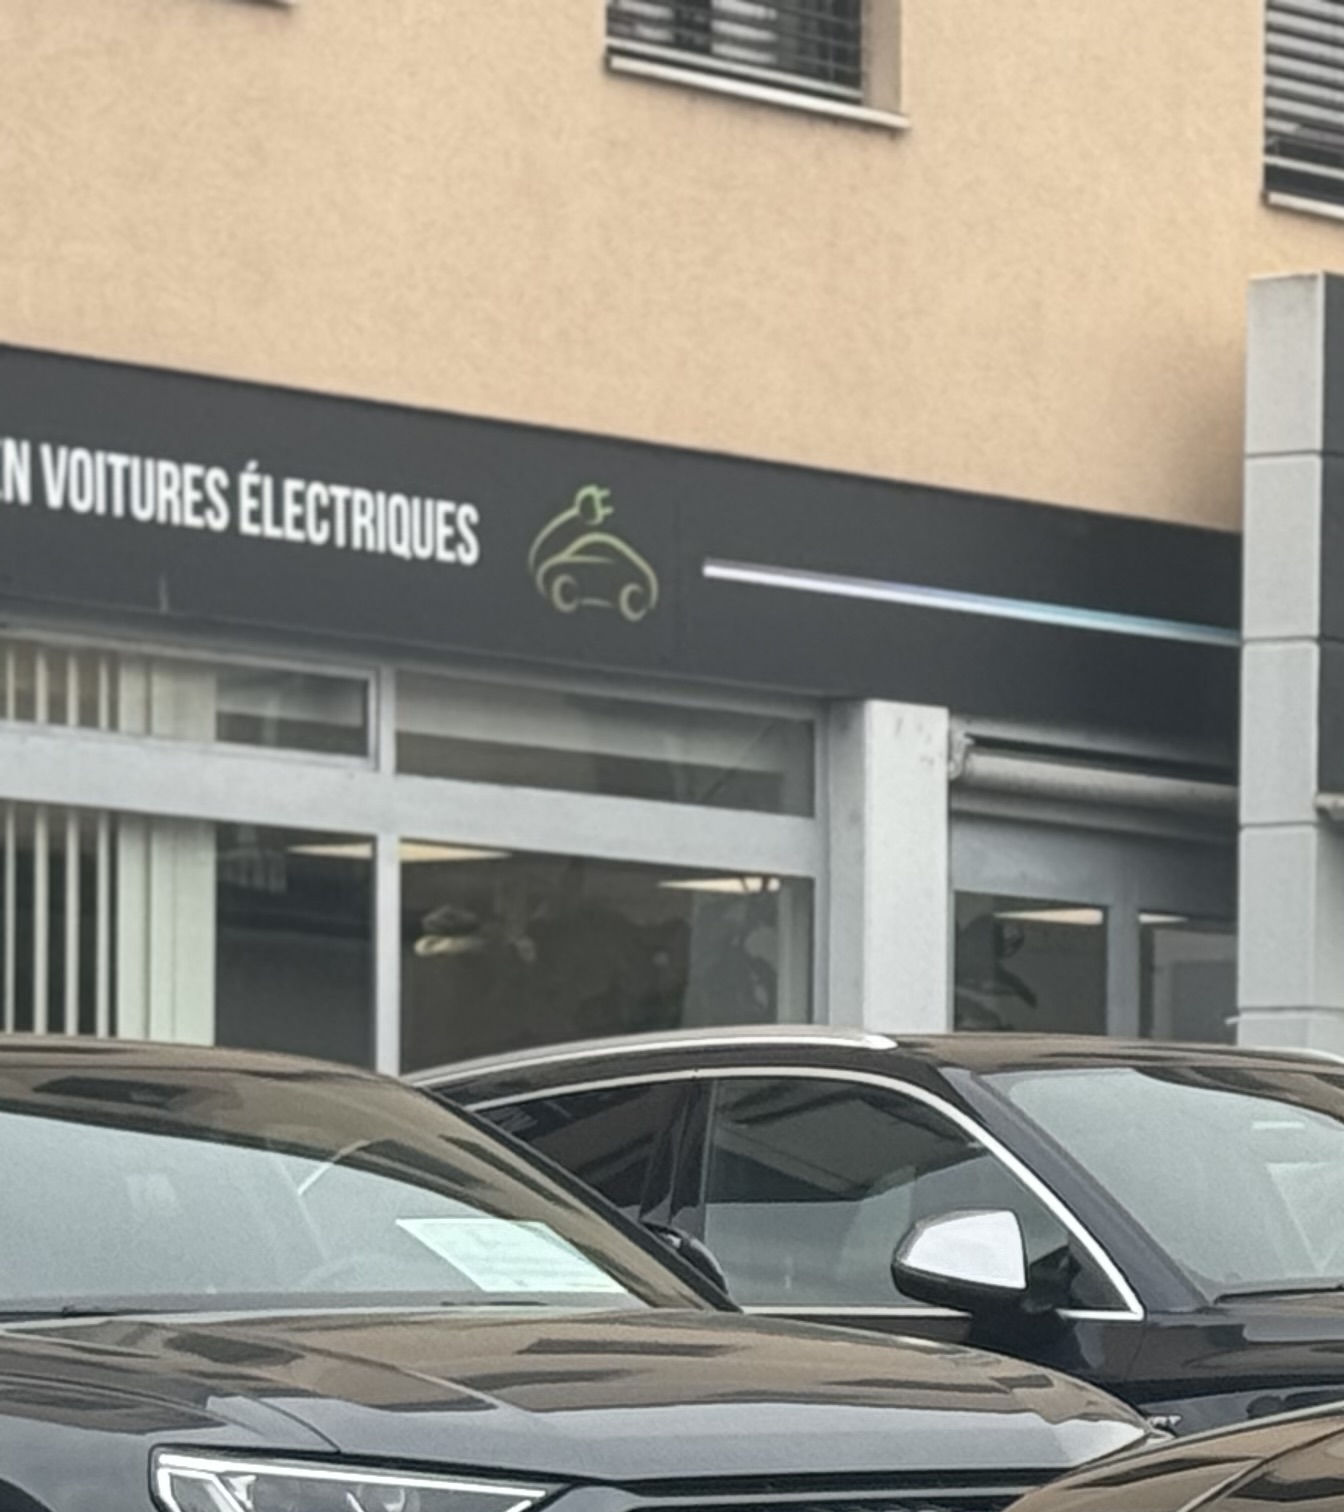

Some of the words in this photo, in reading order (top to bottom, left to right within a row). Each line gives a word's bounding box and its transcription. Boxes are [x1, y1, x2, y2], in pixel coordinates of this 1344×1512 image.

[0, 437, 31, 505] N
[39, 443, 229, 532] VOITURES
[239, 460, 480, 565] ÉLECTRIQUES
